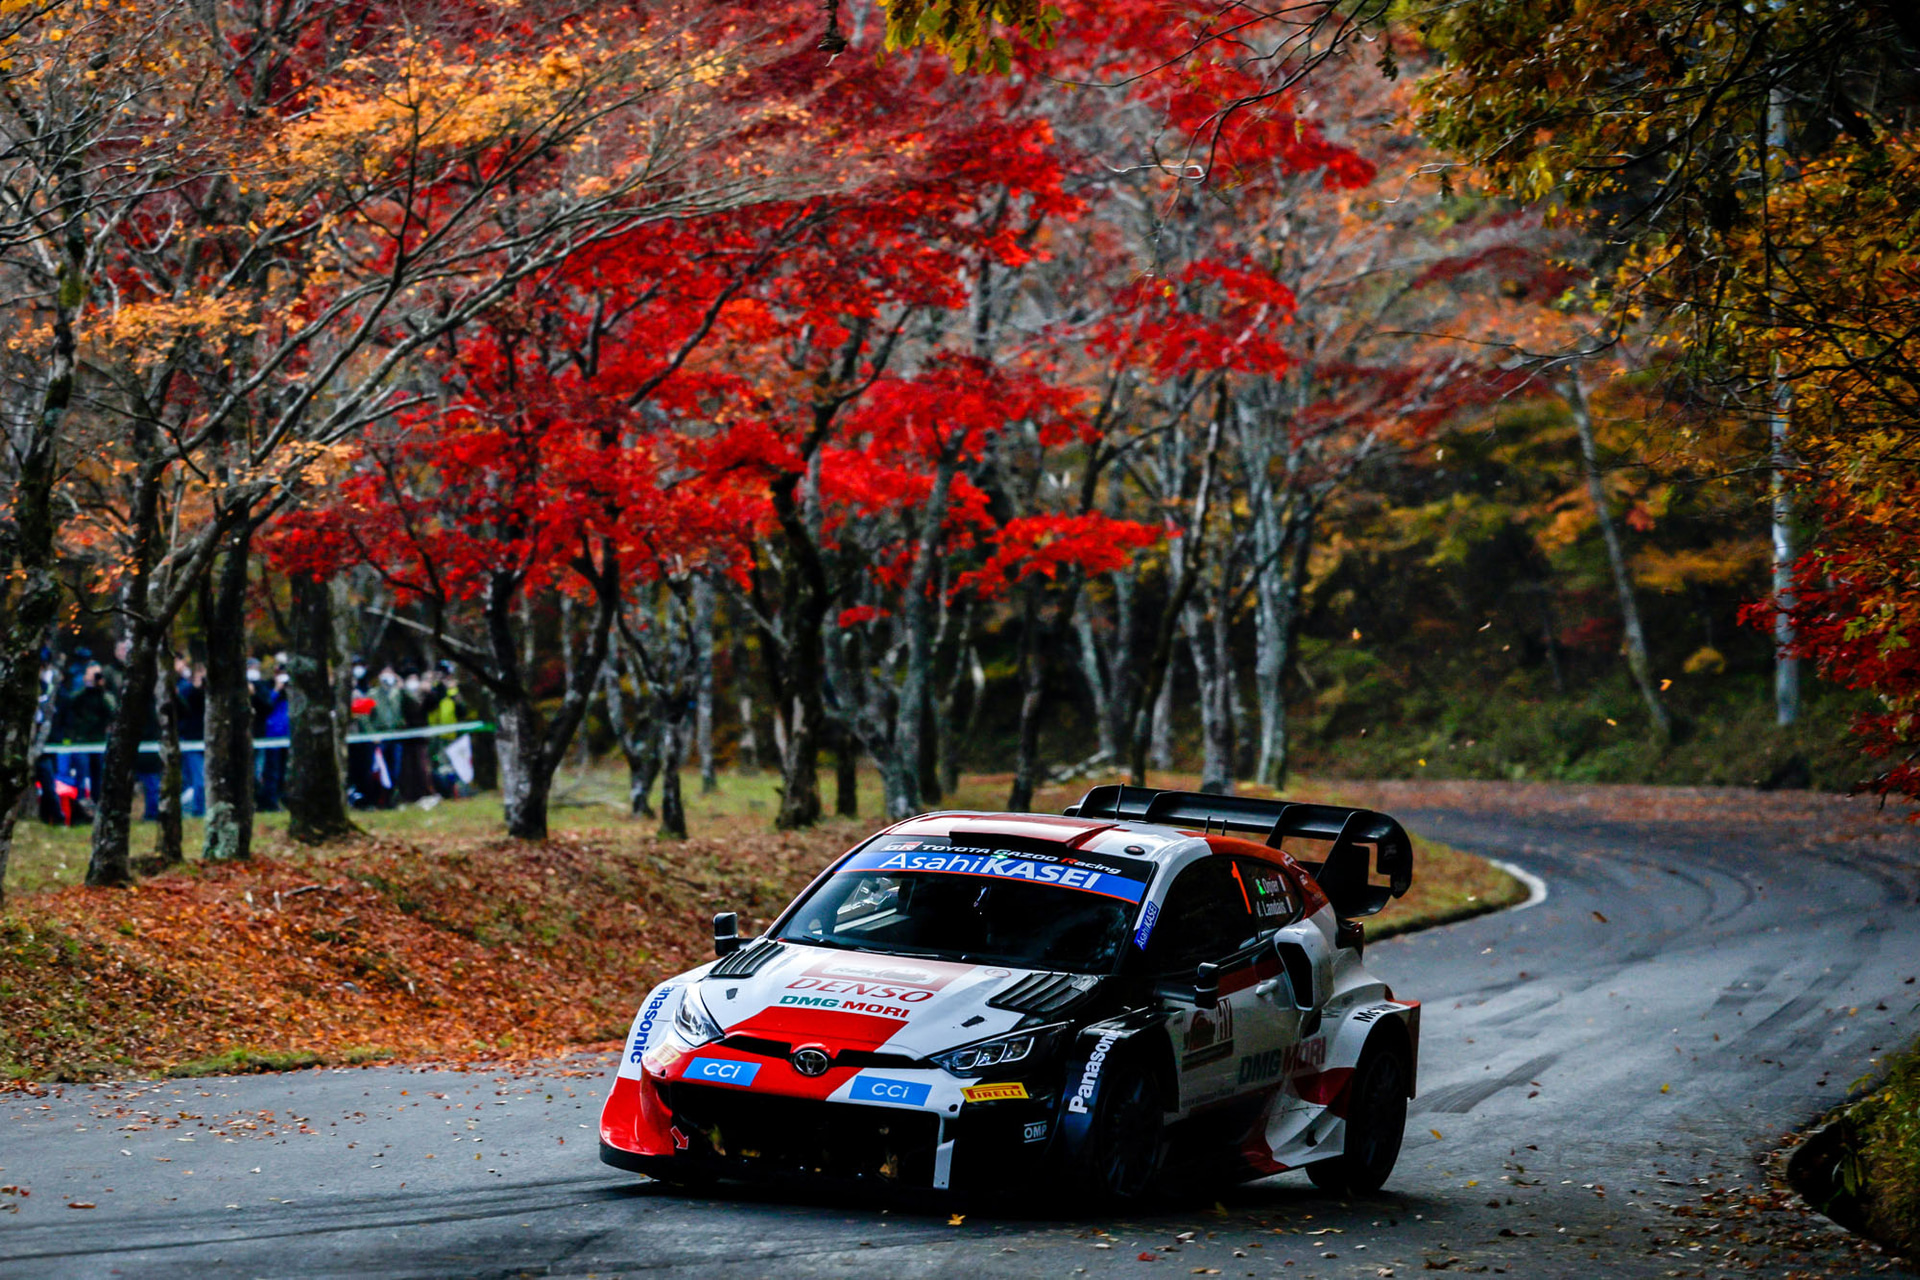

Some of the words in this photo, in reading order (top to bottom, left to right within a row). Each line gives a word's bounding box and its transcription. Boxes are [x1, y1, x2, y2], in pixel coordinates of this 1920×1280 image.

[922, 844, 990, 855] TOYOTA
[994, 848, 1058, 862] GAZOO
[1060, 856, 1122, 874] Racing
[1231, 860, 1252, 914] 1
[785, 977, 935, 1003] DENSO
[778, 995, 840, 1009] DMG
[842, 1000, 910, 1018] MORI
[630, 985, 675, 1064] anasonic
[1238, 1049, 1281, 1085] DMG
[967, 1084, 1023, 1100] PIRELLI
[1023, 1122, 1048, 1141] OMP
